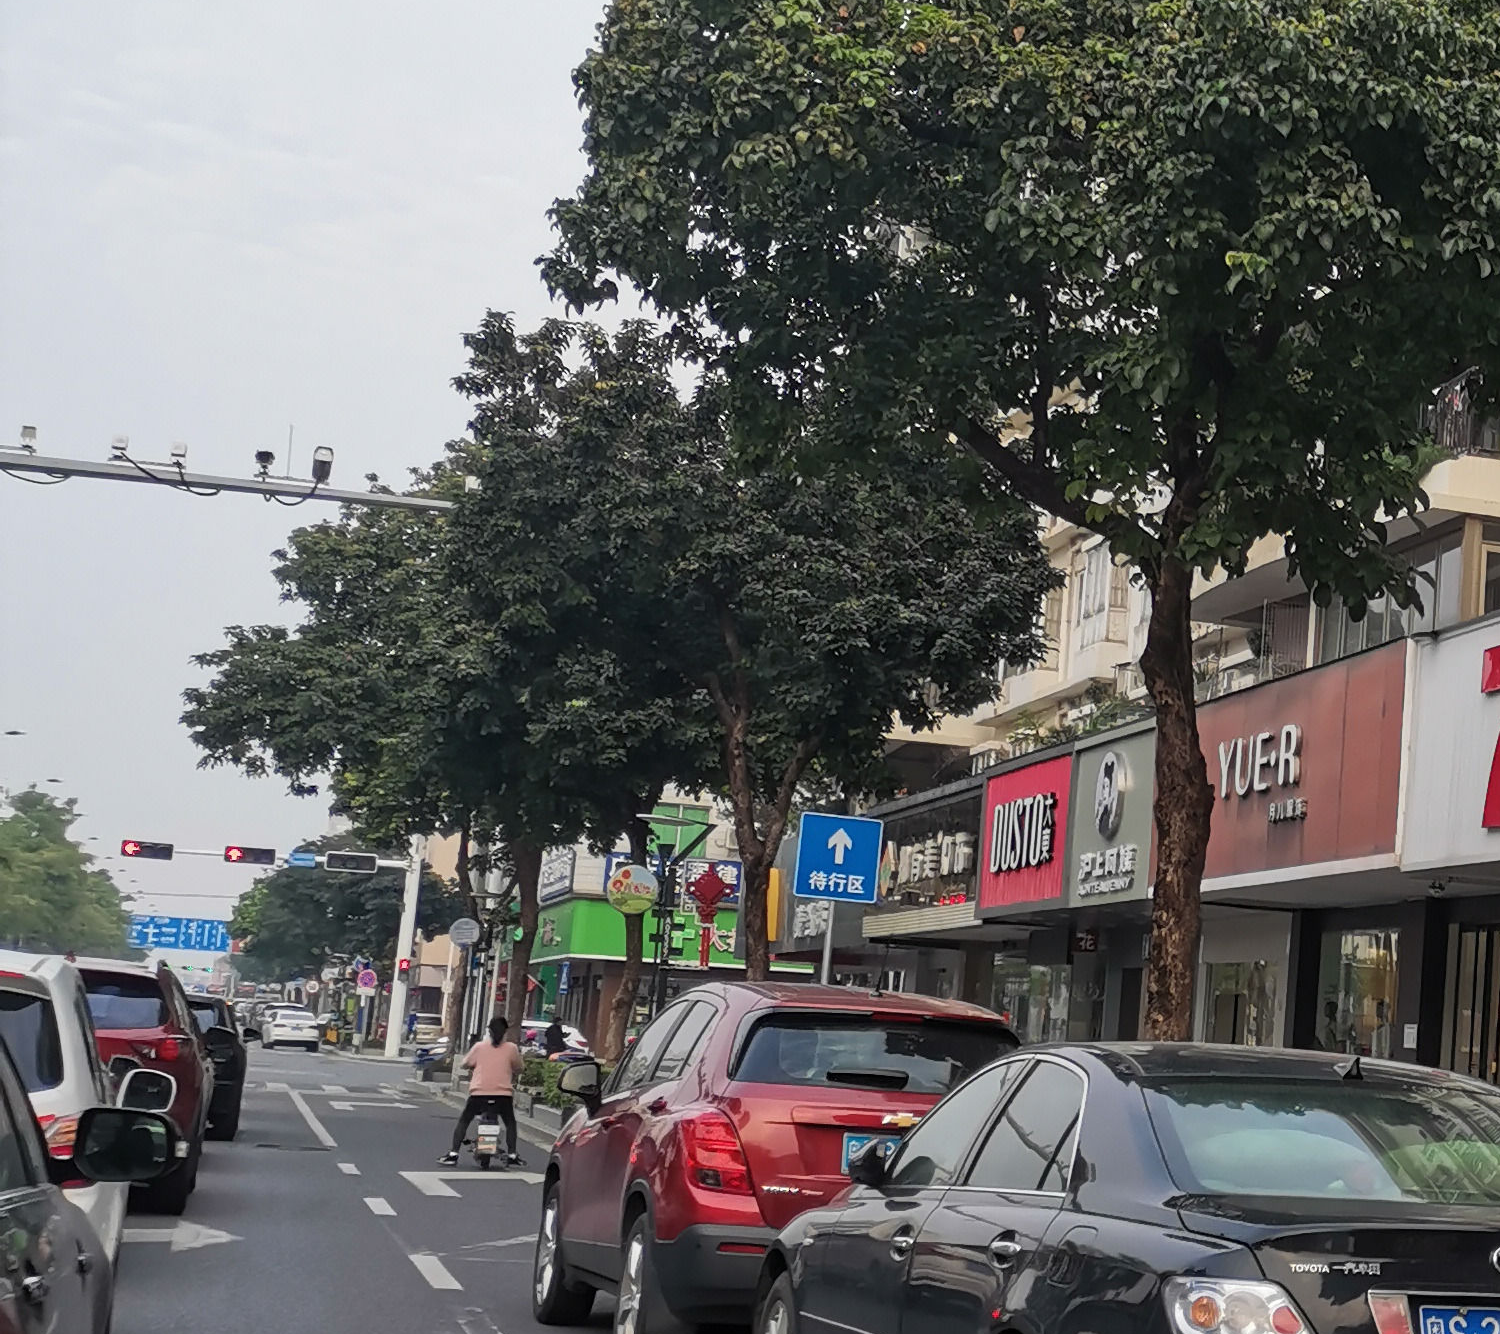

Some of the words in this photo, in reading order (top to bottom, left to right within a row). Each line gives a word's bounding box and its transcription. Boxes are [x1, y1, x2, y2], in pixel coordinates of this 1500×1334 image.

[990, 794, 1042, 873] DUSTO
[808, 870, 865, 894] 待行区
[1289, 1263, 1330, 1274] TOYOTA
